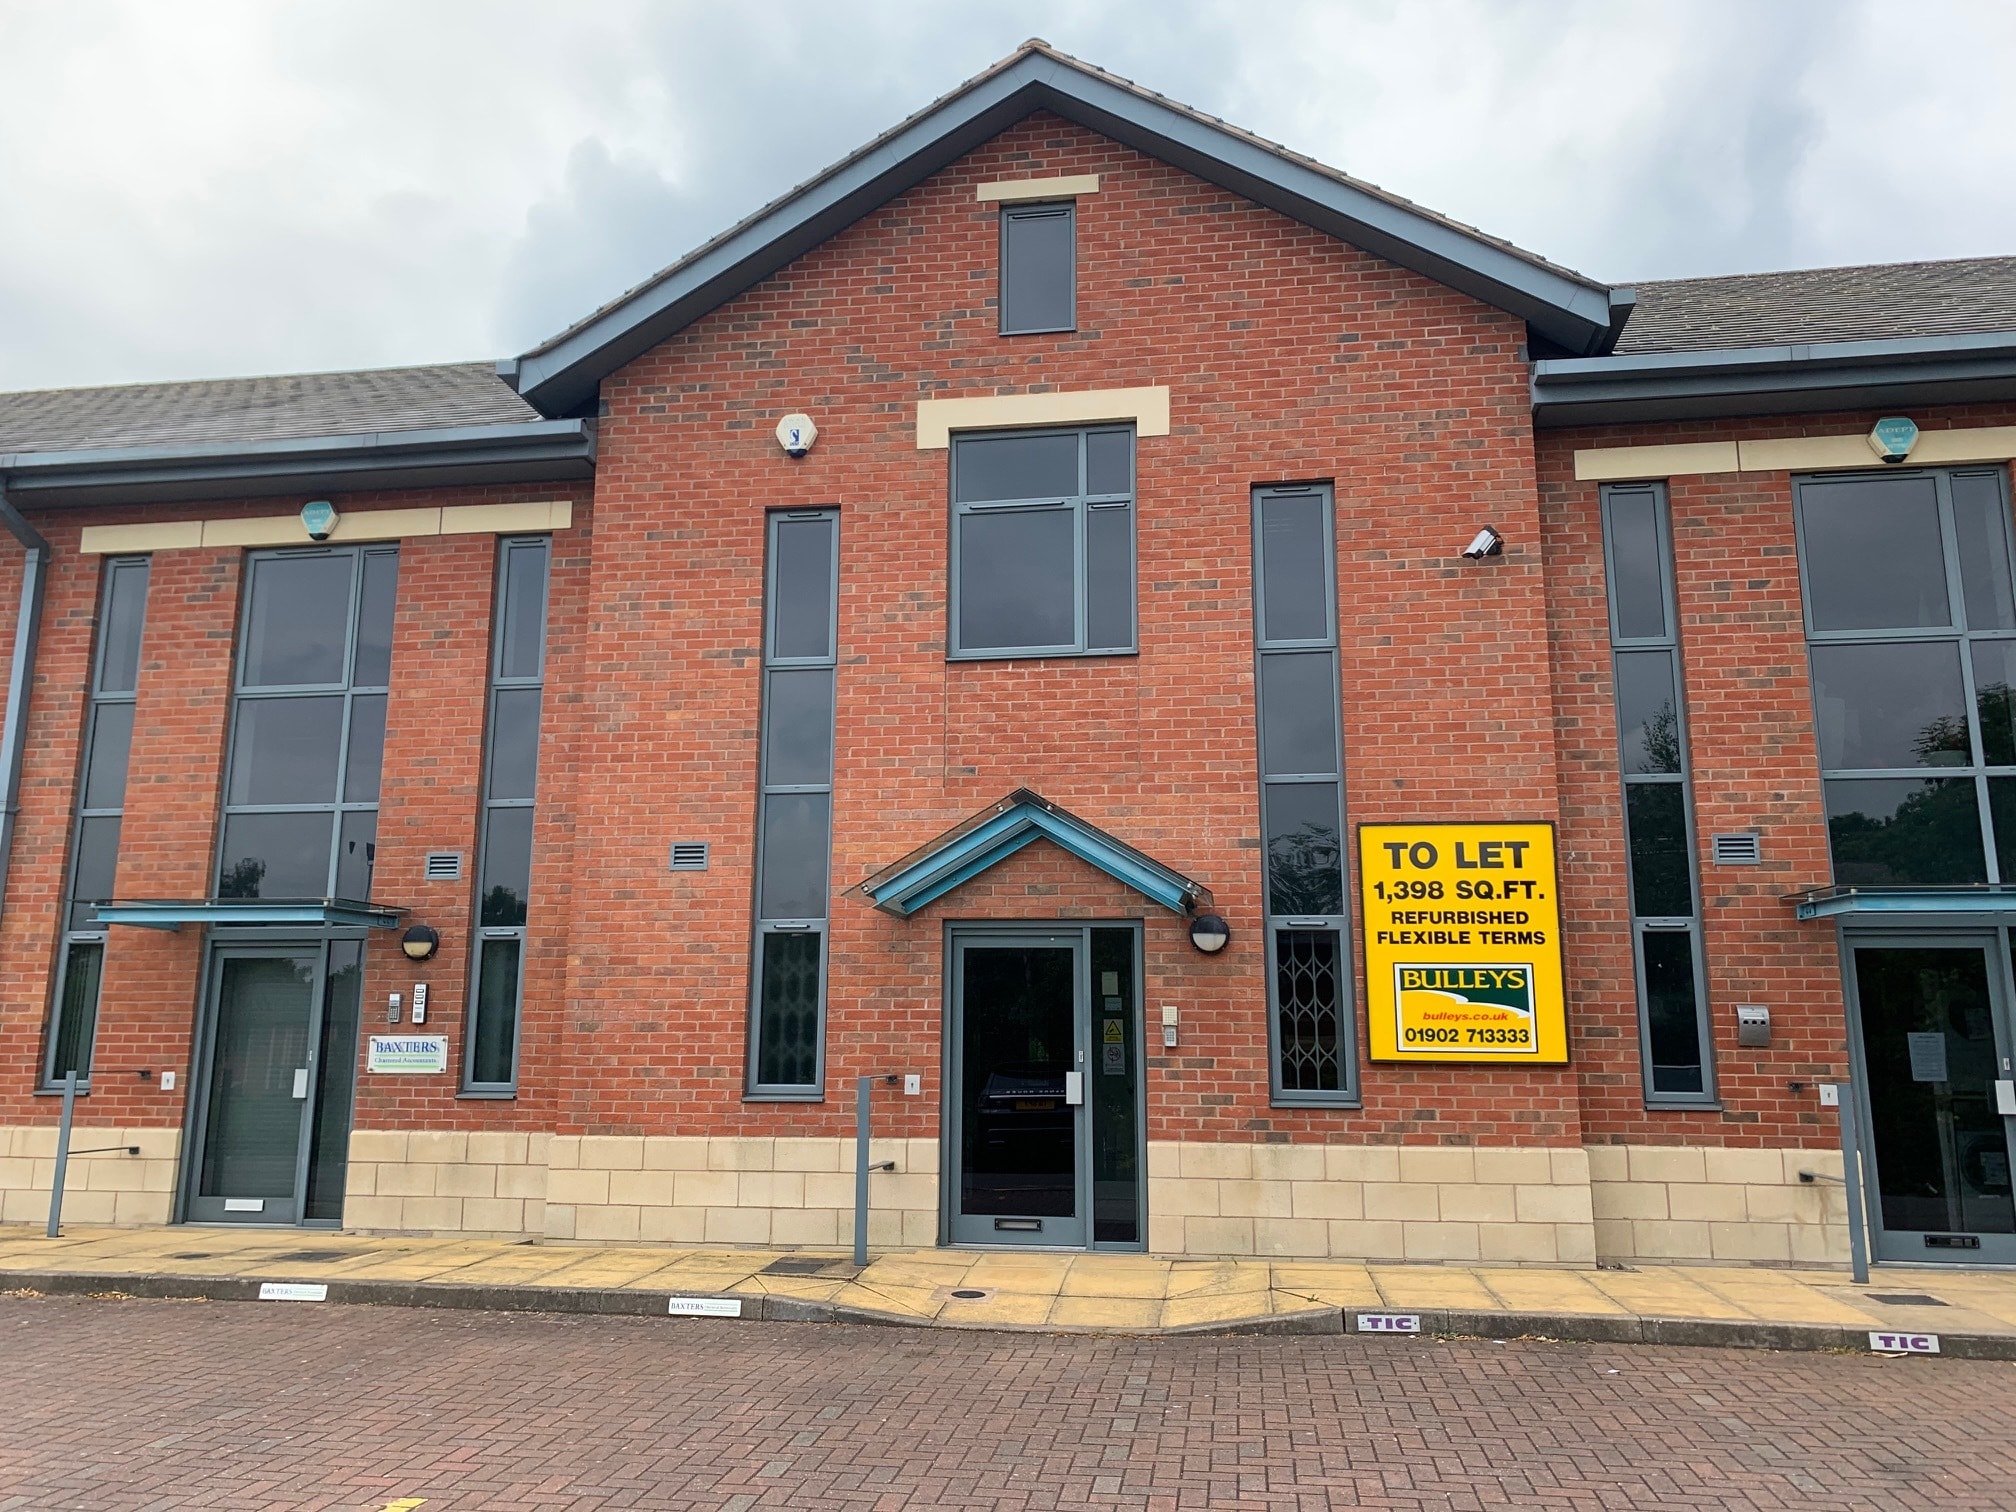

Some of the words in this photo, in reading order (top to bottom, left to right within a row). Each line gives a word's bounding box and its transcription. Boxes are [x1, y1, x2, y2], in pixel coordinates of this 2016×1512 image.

[1383, 841, 1438, 869] TO
[1455, 841, 1529, 869] LET
[1373, 880, 1444, 904] 1,398
[1456, 880, 1545, 900] SQ.FT.
[1391, 911, 1529, 925] REFURBISHED
[1377, 931, 1471, 945] FLEXIBLE
[1478, 931, 1546, 945] TERMS
[1403, 969, 1525, 989] BULLEYS
[1422, 1011, 1508, 1022] bulleys.co.uk
[1405, 1028, 1459, 1043] 01902
[1466, 1028, 1530, 1043] 713333
[375, 1041, 438, 1053] BAXTERS
[262, 1287, 293, 1296] BAXTERS
[671, 1302, 704, 1311] BAXTERS
[1367, 1317, 1412, 1330] TIC
[1878, 1335, 1930, 1350] TIC
